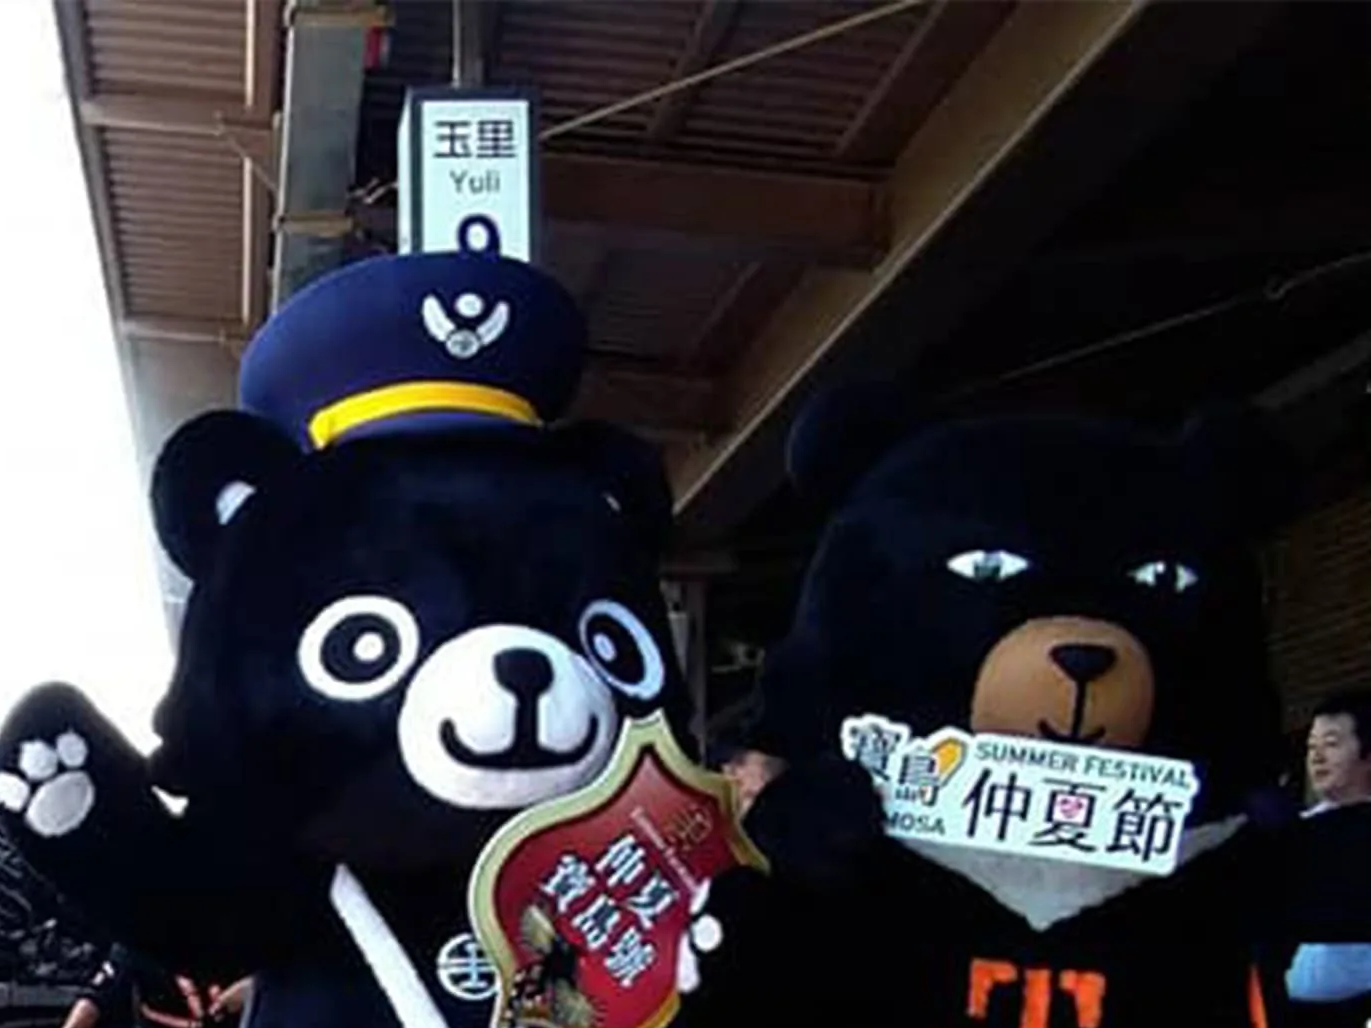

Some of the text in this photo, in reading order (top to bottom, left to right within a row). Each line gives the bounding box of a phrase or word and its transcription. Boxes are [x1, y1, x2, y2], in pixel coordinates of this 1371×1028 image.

[433, 120, 517, 159] 玉里
[450, 170, 501, 194] Yuli
[975, 741, 1192, 789] SUMMER FESTIVAL
[961, 767, 1184, 862] 仲夏節
[595, 834, 680, 930] 仲夏
